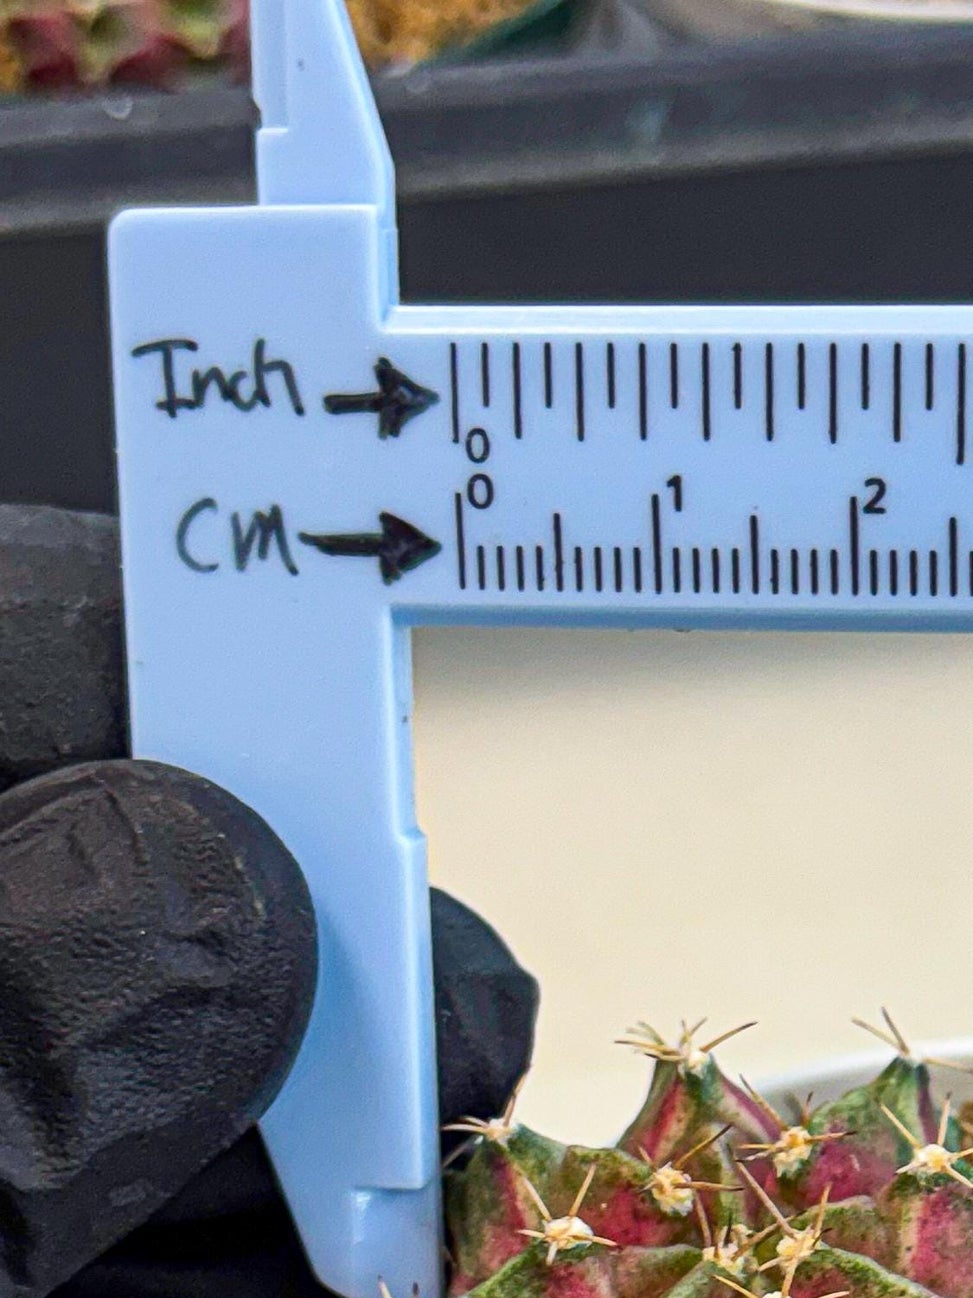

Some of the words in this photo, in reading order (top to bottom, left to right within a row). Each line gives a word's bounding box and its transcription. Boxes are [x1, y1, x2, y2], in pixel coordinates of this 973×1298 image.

[131, 338, 306, 419] Inch
[465, 427, 491, 464] 0
[466, 473, 494, 510] 0
[666, 474, 683, 513] 1
[862, 477, 887, 515] 2
